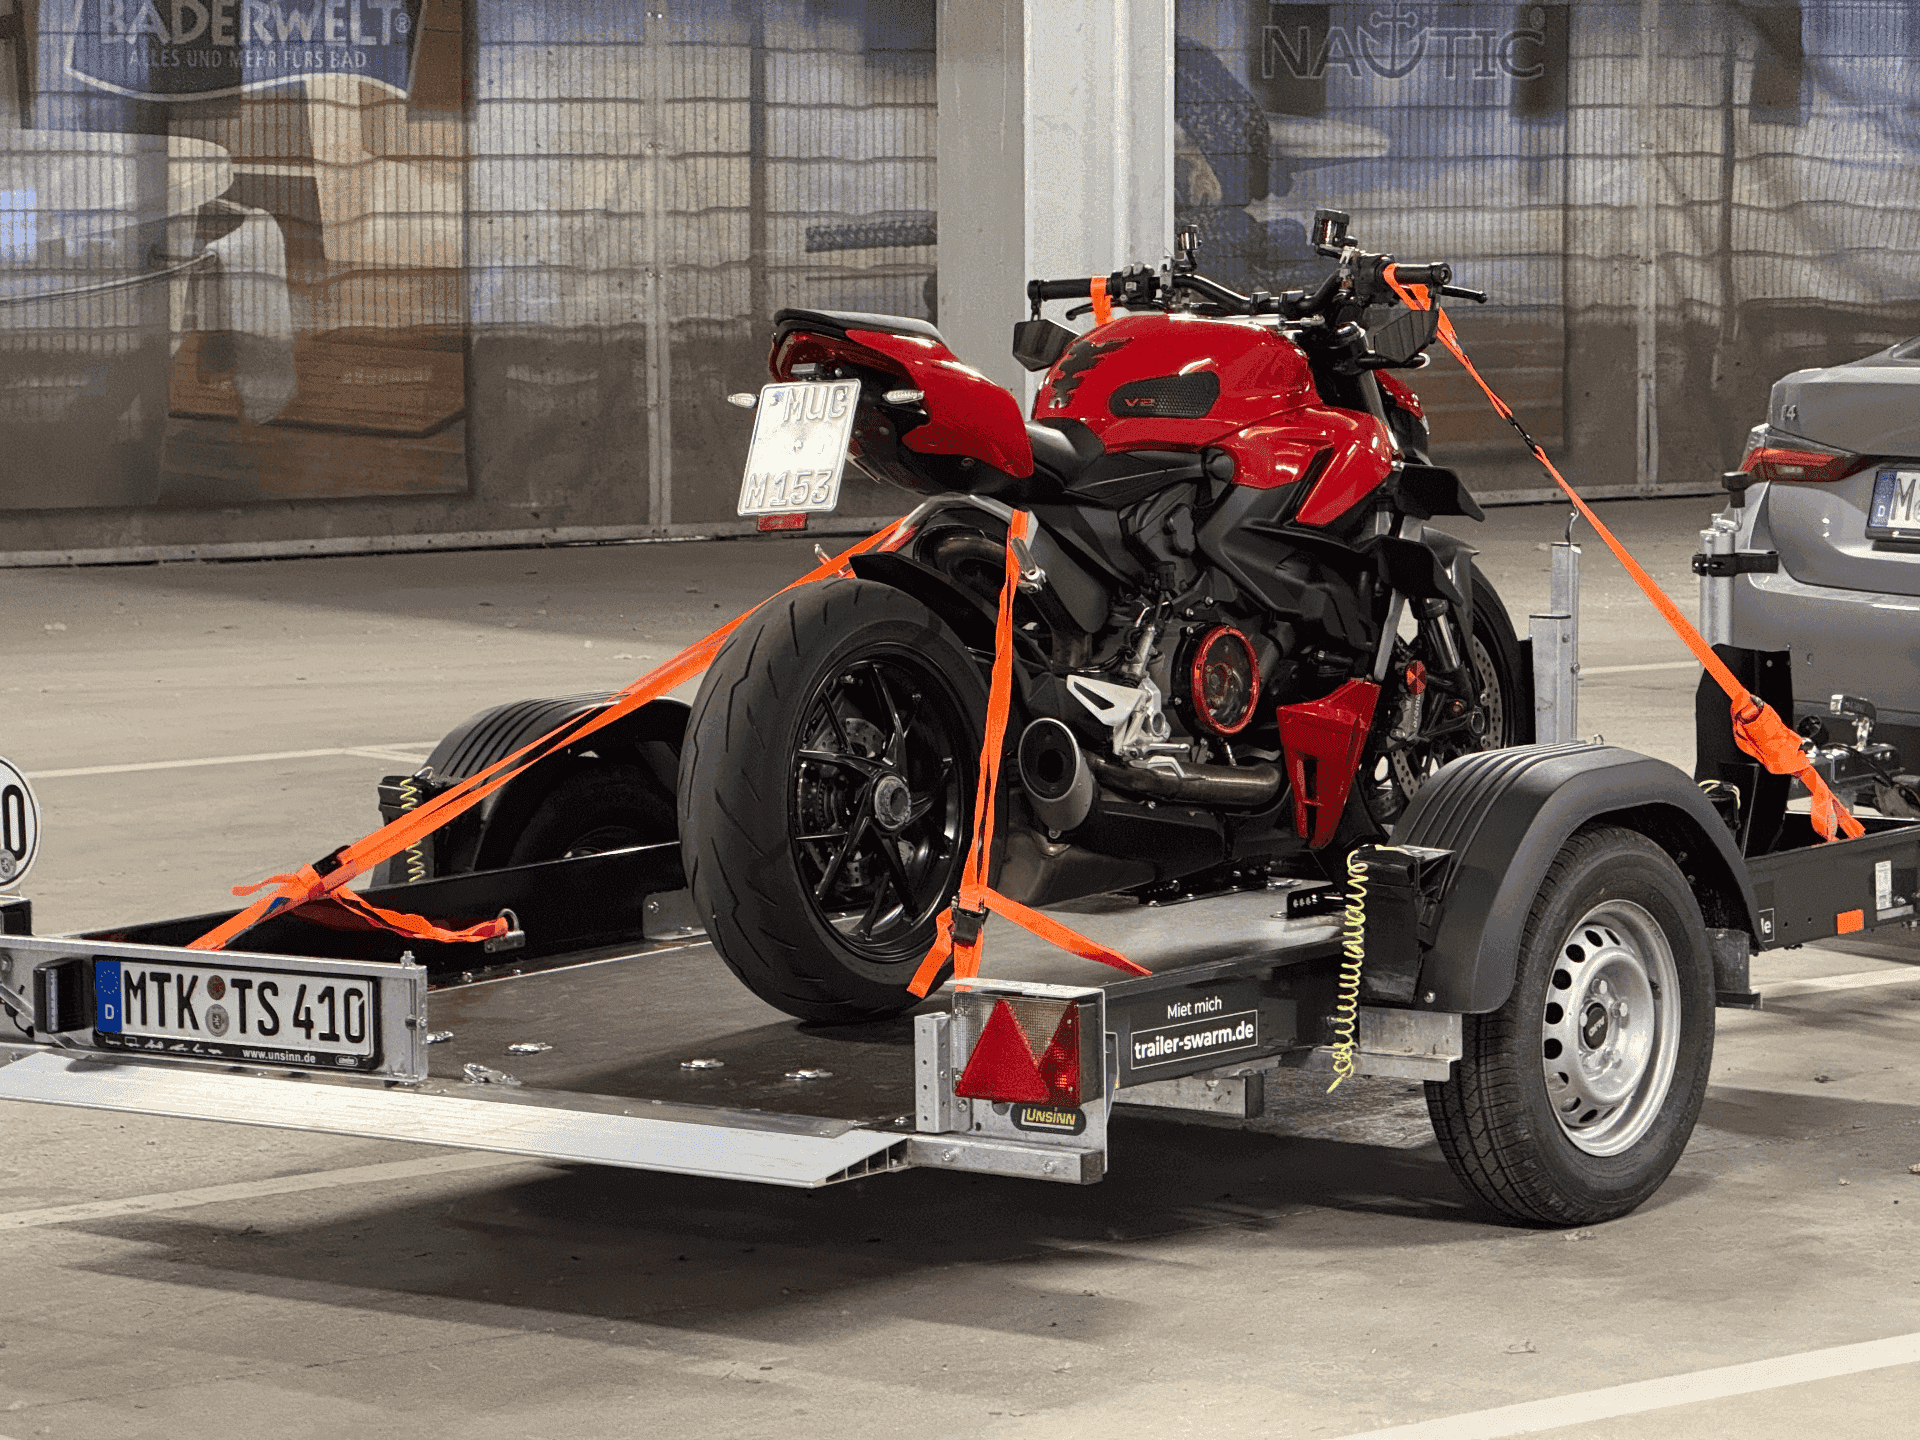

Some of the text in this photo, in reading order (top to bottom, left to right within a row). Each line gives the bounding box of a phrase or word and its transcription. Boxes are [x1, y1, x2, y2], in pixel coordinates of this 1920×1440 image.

[129, 50, 181, 68] ALLES
[187, 50, 222, 68] UND
[330, 50, 367, 68] BAD
[783, 385, 849, 422] MUC
[1125, 398, 1155, 407] V2
[104, 970, 365, 1043] D MTK TS 410
[1167, 995, 1222, 1019] Miet mich
[1134, 1020, 1254, 1060] trailer-swarm.de
[242, 1049, 316, 1064] www.unsinn.de
